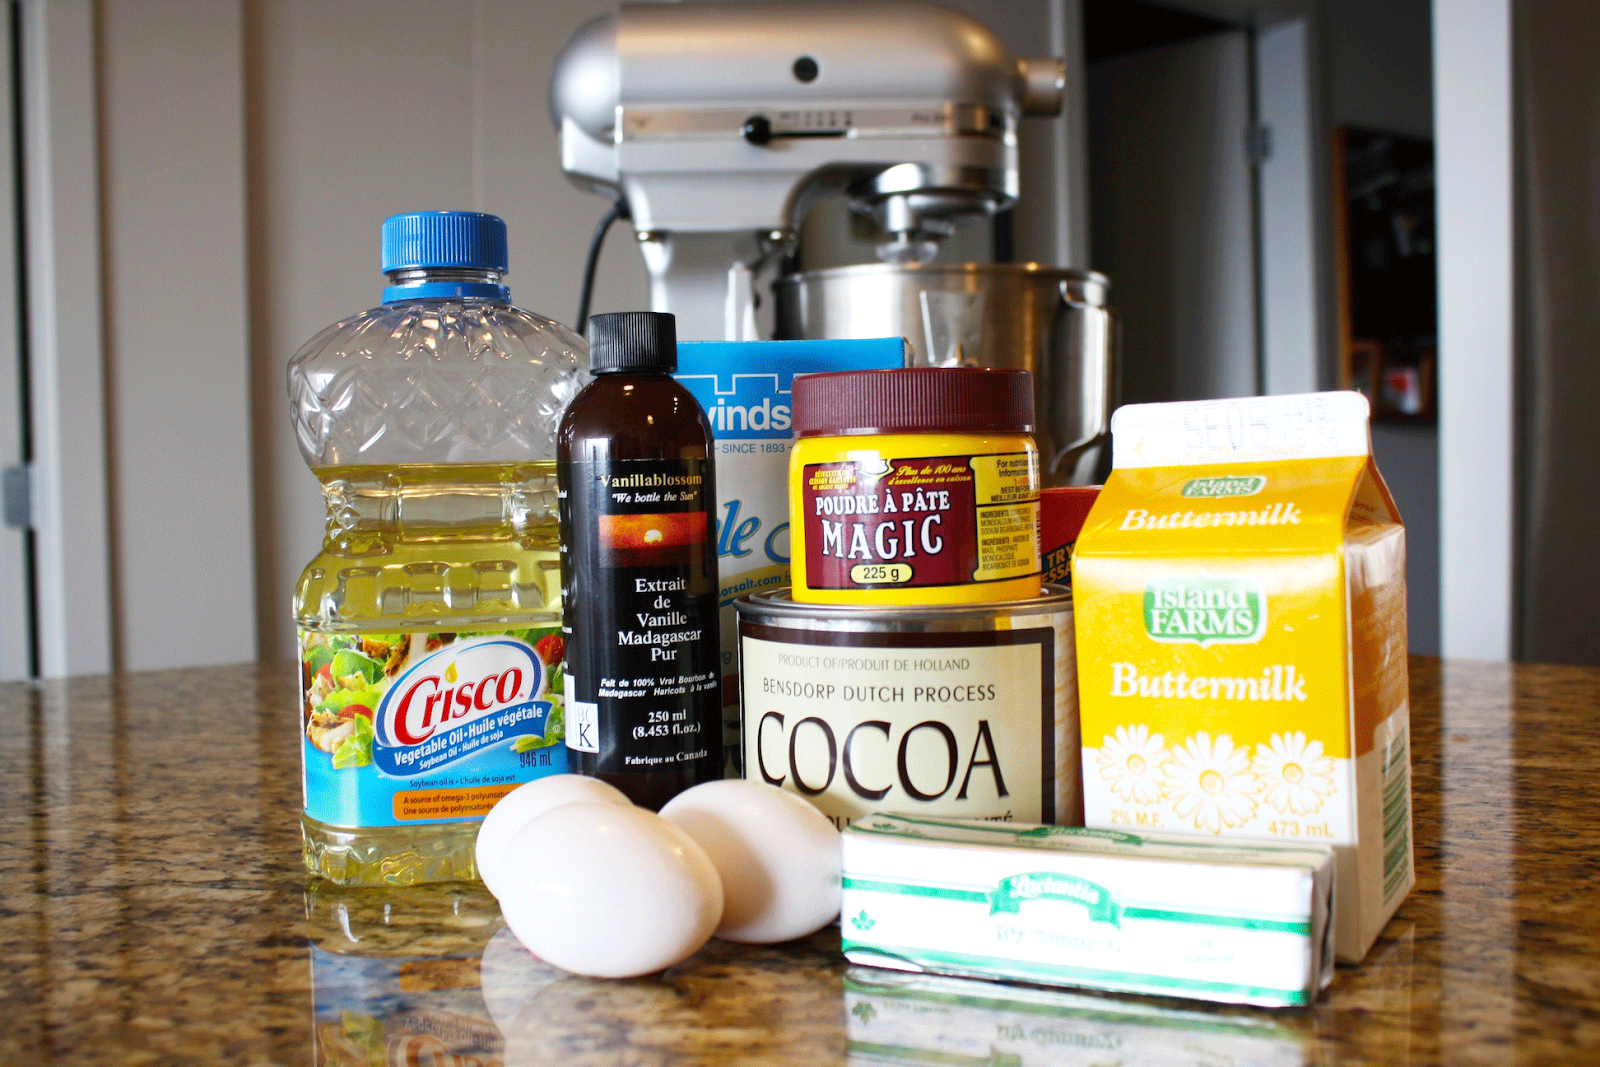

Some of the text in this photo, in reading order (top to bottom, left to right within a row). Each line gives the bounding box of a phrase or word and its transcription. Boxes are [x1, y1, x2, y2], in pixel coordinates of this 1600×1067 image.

[721, 442, 786, 454] SINCE 1893
[920, 465, 933, 475] de
[934, 463, 952, 475] 100
[997, 459, 1008, 469] For
[600, 473, 702, 488] Vanillablossom
[634, 491, 661, 503] bottle
[663, 490, 678, 501] the
[815, 486, 950, 516] POUDRE À PÂTE
[1119, 502, 1302, 531] Buttermilk
[821, 513, 944, 561] MAGIC
[1046, 542, 1075, 568] TRY
[862, 566, 900, 582] 225 g
[635, 576, 687, 593] Extrait
[653, 594, 672, 609] de
[1152, 579, 1249, 609] Island
[636, 611, 688, 627] Vanille
[1151, 608, 1254, 635] FARMS
[617, 629, 702, 647] Madagascar
[651, 647, 677, 661] Pur
[778, 653, 970, 672] PRODUCT OF/PRODUIT DE HOLLAND
[600, 678, 616, 688] Fait
[618, 679, 630, 688] de
[633, 678, 655, 687] 100%
[659, 676, 675, 686] Vrai
[678, 674, 707, 685] Bourbon
[1109, 661, 1308, 702] Buttermilk
[598, 688, 647, 699] Madagascar
[653, 685, 686, 697] Haricots
[763, 677, 996, 703] BENSDORP DUTCH PROCESS
[394, 666, 523, 746] Crisco
[648, 708, 687, 723] 250 ml
[394, 704, 543, 767] Vegetable Oil Huile végétale
[578, 723, 596, 749] K
[631, 725, 670, 740] (8.453
[419, 729, 504, 771] Soybean Oil Huile de soja
[625, 748, 708, 766] Fabrique au Canada
[757, 710, 1010, 802] COCOA
[520, 752, 537, 768] 946
[409, 774, 516, 790] Soybean oil is L'huile de soja est
[403, 796, 410, 804] A
[410, 795, 432, 804] source
[432, 793, 441, 803] of
[441, 793, 470, 805] omega-3
[403, 806, 416, 816] Une
[418, 804, 439, 815] source
[440, 803, 449, 813] de
[1111, 808, 1132, 826] 2%
[1267, 820, 1301, 838] 473
